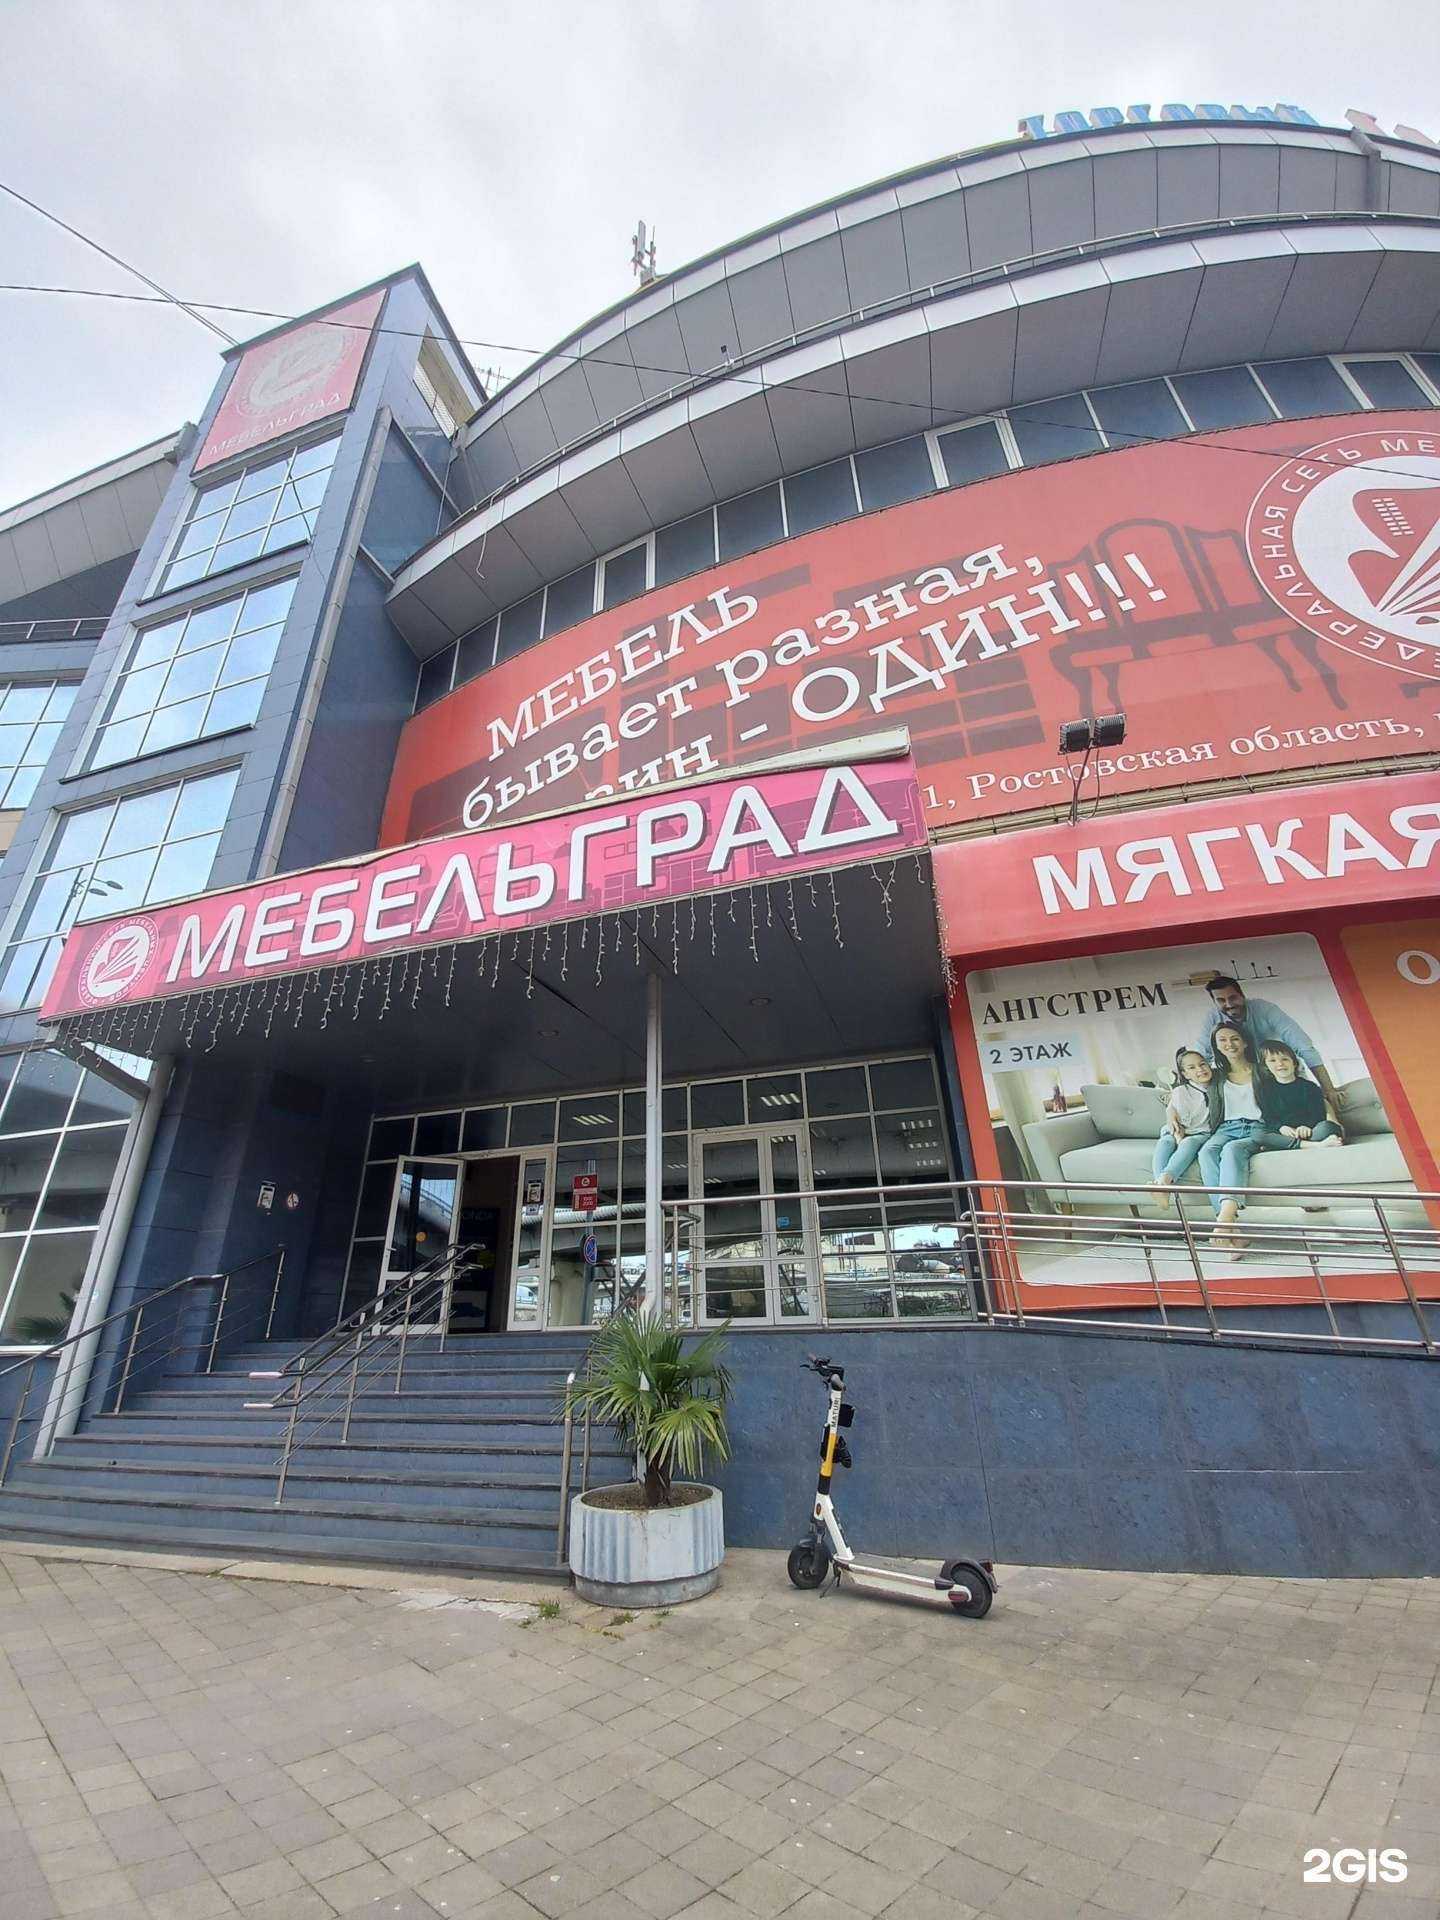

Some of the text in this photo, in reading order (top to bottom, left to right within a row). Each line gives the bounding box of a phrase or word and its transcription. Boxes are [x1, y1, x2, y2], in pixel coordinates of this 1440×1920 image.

[1281, 447, 1362, 494] СЕТЬ
[462, 543, 1044, 830] бывает разная,
[485, 585, 759, 762] МЕБЕЛЬ
[790, 552, 1168, 723] ОДИН!!!
[966, 740, 1219, 801] Ростовская
[1229, 716, 1425, 756] область,
[164, 765, 900, 985] МЕБЕЛЬГРАД
[1031, 802, 1440, 916] МЯГКАЯ
[982, 981, 1170, 1025] АНГСТРЕМ
[989, 1041, 1073, 1065] 2 ЭТАЖ
